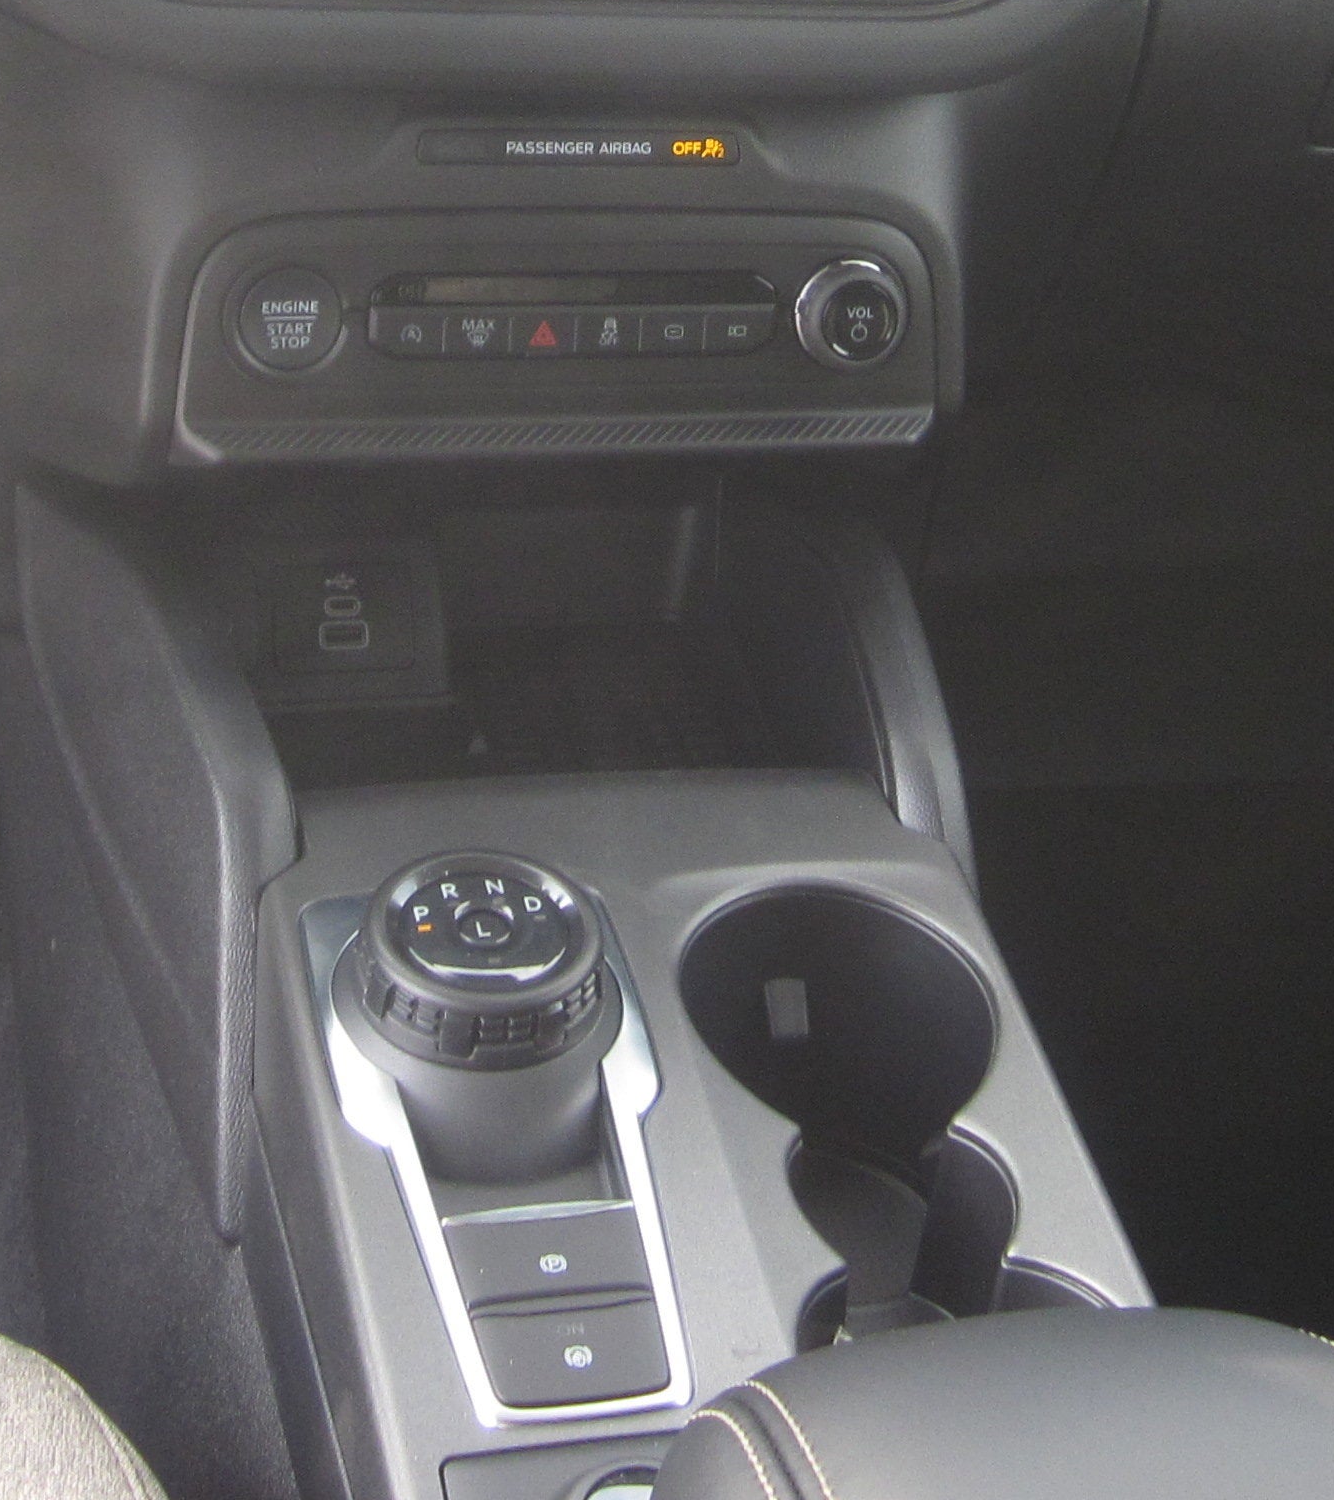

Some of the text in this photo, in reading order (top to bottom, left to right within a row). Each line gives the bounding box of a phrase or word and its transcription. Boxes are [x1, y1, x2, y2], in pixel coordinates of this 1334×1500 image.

[506, 141, 702, 156] PASSENGER AIRBAG OFF
[262, 301, 318, 315] ENGINE
[846, 307, 874, 319] VOL
[267, 322, 313, 336] START
[462, 319, 495, 332] MAX
[270, 336, 310, 350] STOP
[440, 883, 459, 899] R
[485, 879, 505, 894] N
[524, 896, 542, 912] D
[413, 905, 429, 922] P
[475, 921, 491, 938] L
